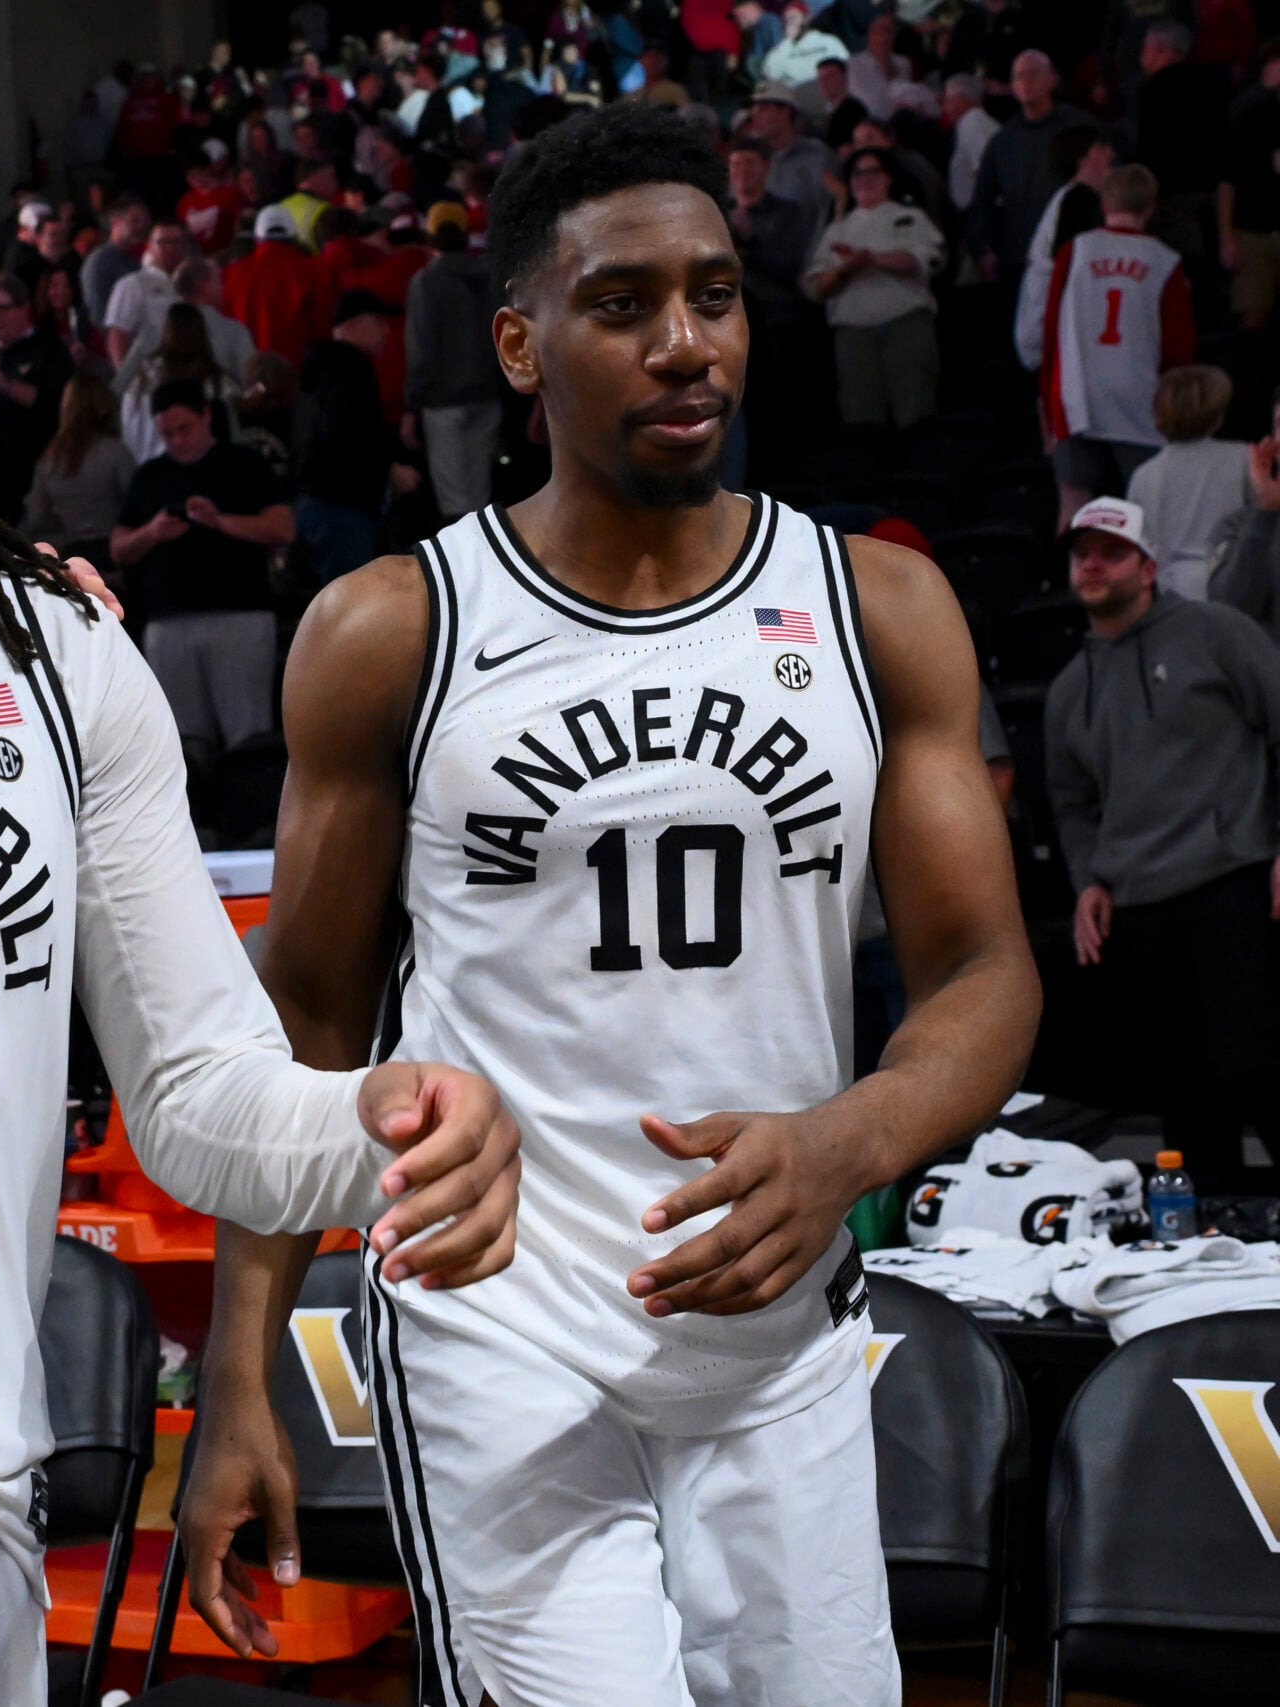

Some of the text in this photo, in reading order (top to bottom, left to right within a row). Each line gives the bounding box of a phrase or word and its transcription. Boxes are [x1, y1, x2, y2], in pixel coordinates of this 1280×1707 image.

[1098, 288, 1122, 346] 1
[777, 655, 810, 688] SEC
[462, 686, 843, 886] VANDERBILT
[586, 824, 745, 971] 10
[1021, 1194, 1078, 1246] G
